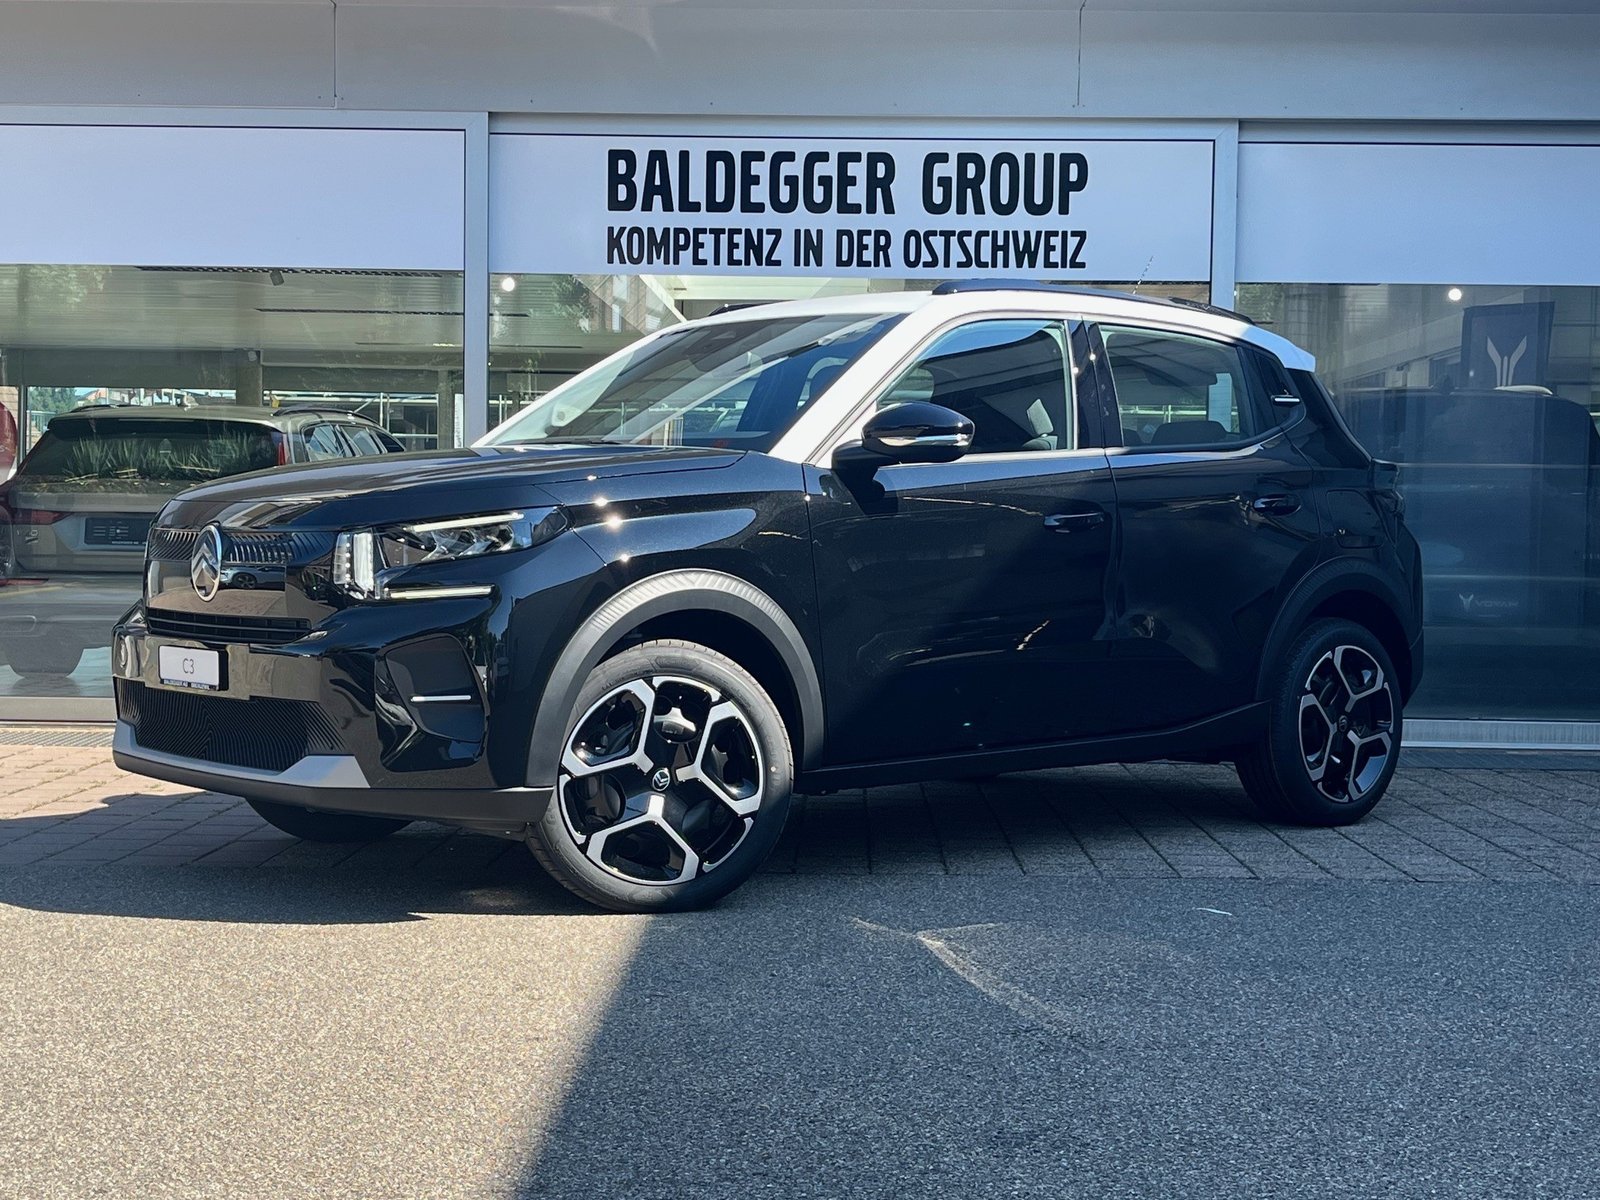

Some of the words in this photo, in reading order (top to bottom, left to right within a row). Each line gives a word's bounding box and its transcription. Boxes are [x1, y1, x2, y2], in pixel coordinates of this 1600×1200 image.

[607, 148, 896, 215] BALDEGGER
[921, 152, 1089, 216] GROUP
[606, 226, 783, 267] KOMPETENZ
[793, 228, 824, 267] IN
[835, 229, 892, 268] DER
[903, 229, 1087, 269] OSTSCHWEIZ
[183, 658, 195, 674] C3
